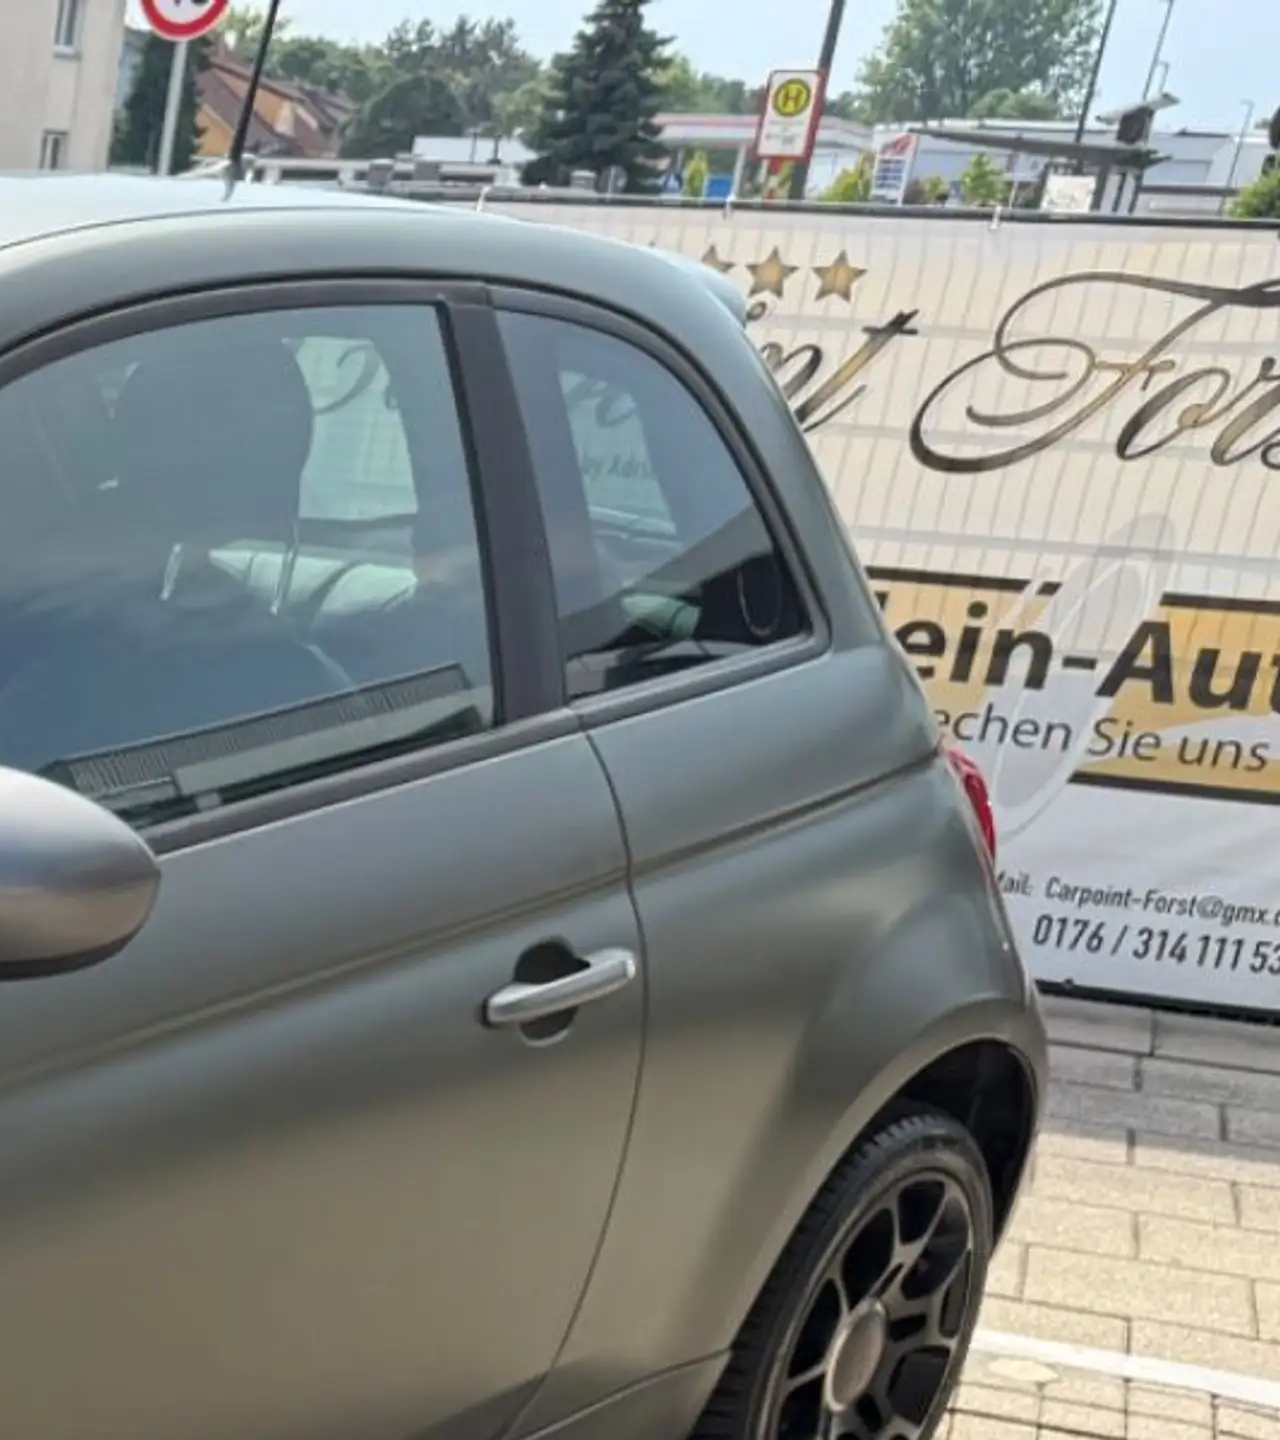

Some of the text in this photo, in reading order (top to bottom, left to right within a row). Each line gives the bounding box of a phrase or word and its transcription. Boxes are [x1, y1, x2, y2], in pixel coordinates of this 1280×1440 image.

[910, 271, 1280, 473] For
[874, 590, 1280, 715] ein-Au
[1086, 716, 1162, 762] Sie
[1177, 735, 1270, 773] uns
[1032, 913, 1107, 955] 0176
[1132, 926, 1190, 964] 314
[1196, 933, 1246, 971] 111
